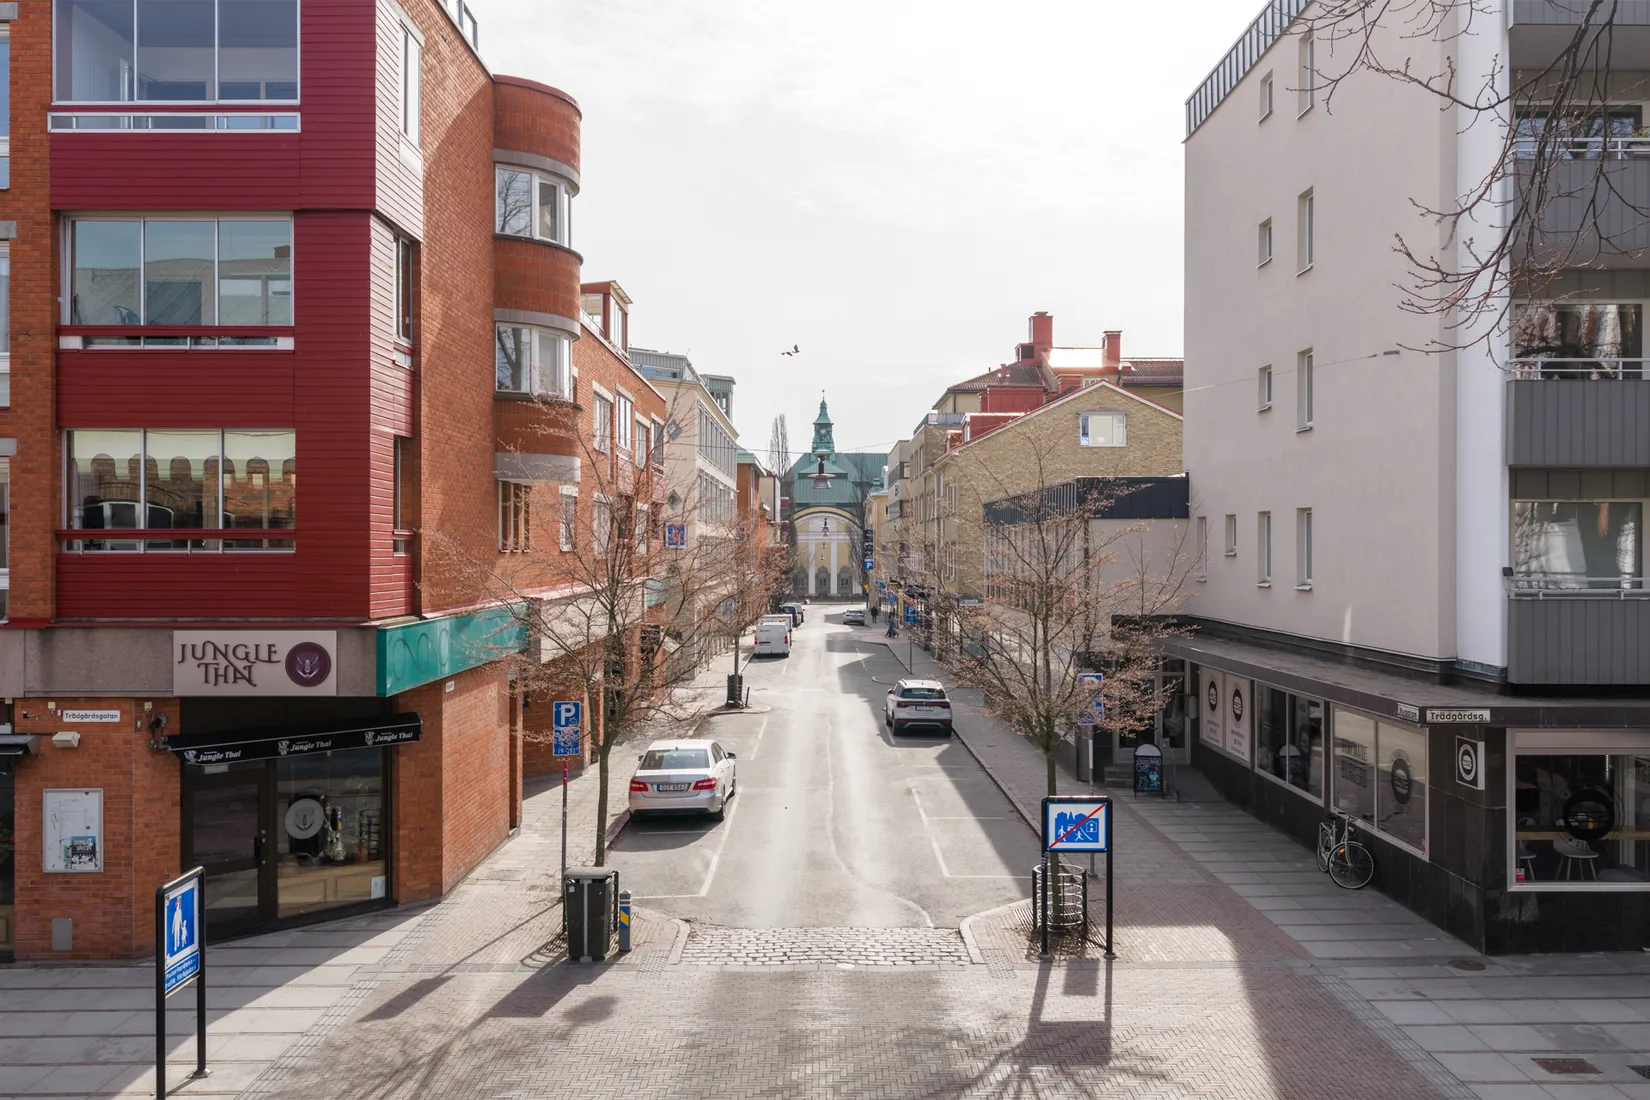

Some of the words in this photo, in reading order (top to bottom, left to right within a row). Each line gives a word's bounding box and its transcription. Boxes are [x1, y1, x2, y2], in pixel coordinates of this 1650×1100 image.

[177, 640, 282, 664] JUNGLE
[197, 662, 257, 687] THAI
[64, 712, 119, 720] Trädgårdsgatan
[560, 704, 576, 726] P
[1430, 711, 1487, 721] Trädgårdsg.
[375, 733, 398, 742] Jungle
[399, 731, 413, 739] Thai
[290, 742, 315, 752] Jungle
[316, 740, 332, 748] Thai
[197, 752, 224, 762] Jungle
[225, 750, 242, 759] Thai
